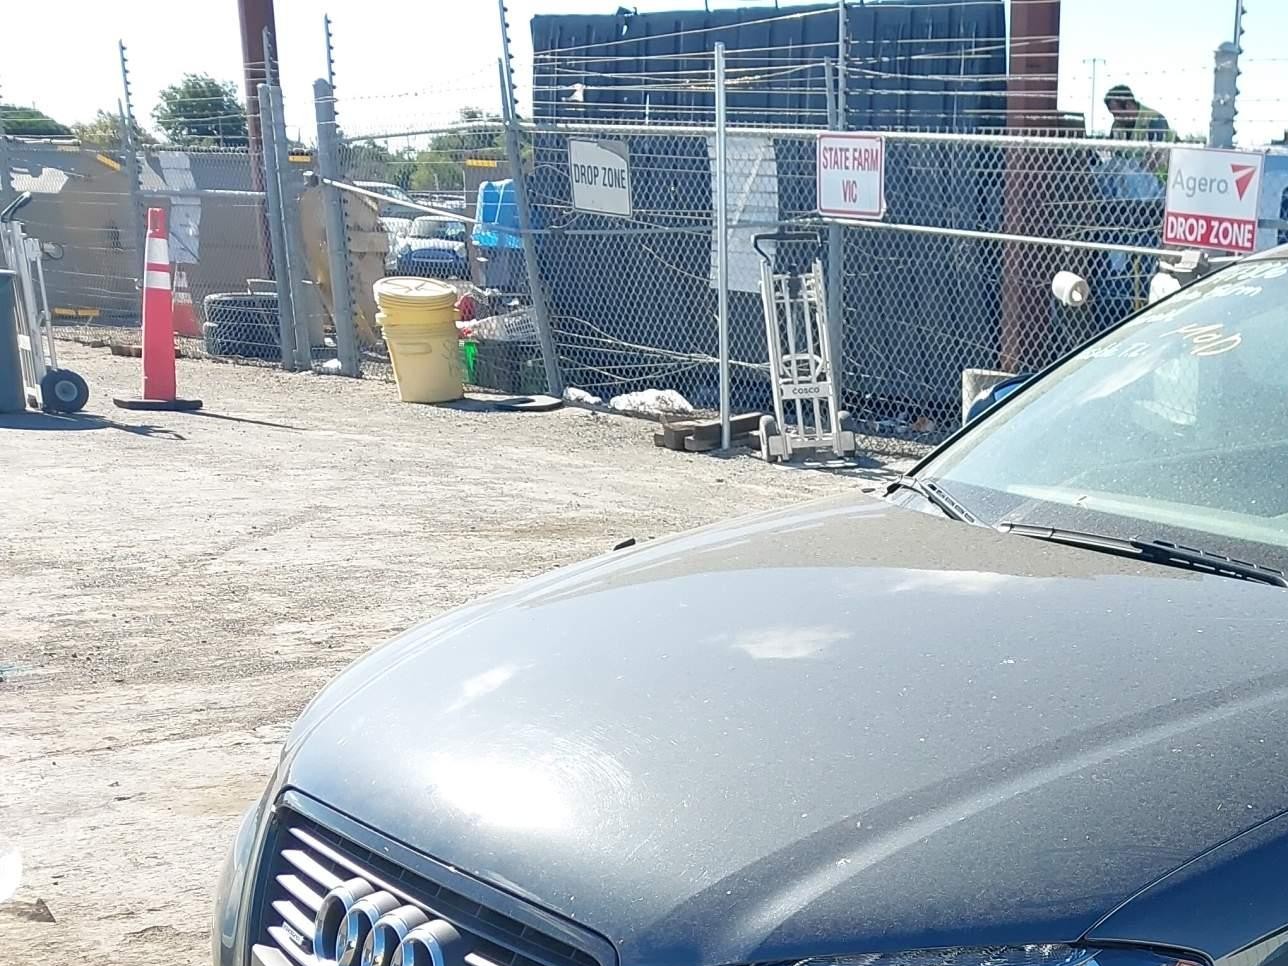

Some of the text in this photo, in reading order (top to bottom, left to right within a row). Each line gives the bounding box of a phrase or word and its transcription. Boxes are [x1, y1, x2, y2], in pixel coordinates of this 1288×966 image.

[822, 145, 879, 172] STATE FARM
[573, 163, 627, 190] DROP ZONE
[1171, 167, 1229, 198] Agero
[842, 179, 858, 204] VIC
[1166, 215, 1254, 249] DROP ZONE
[792, 386, 821, 395] COSCO
